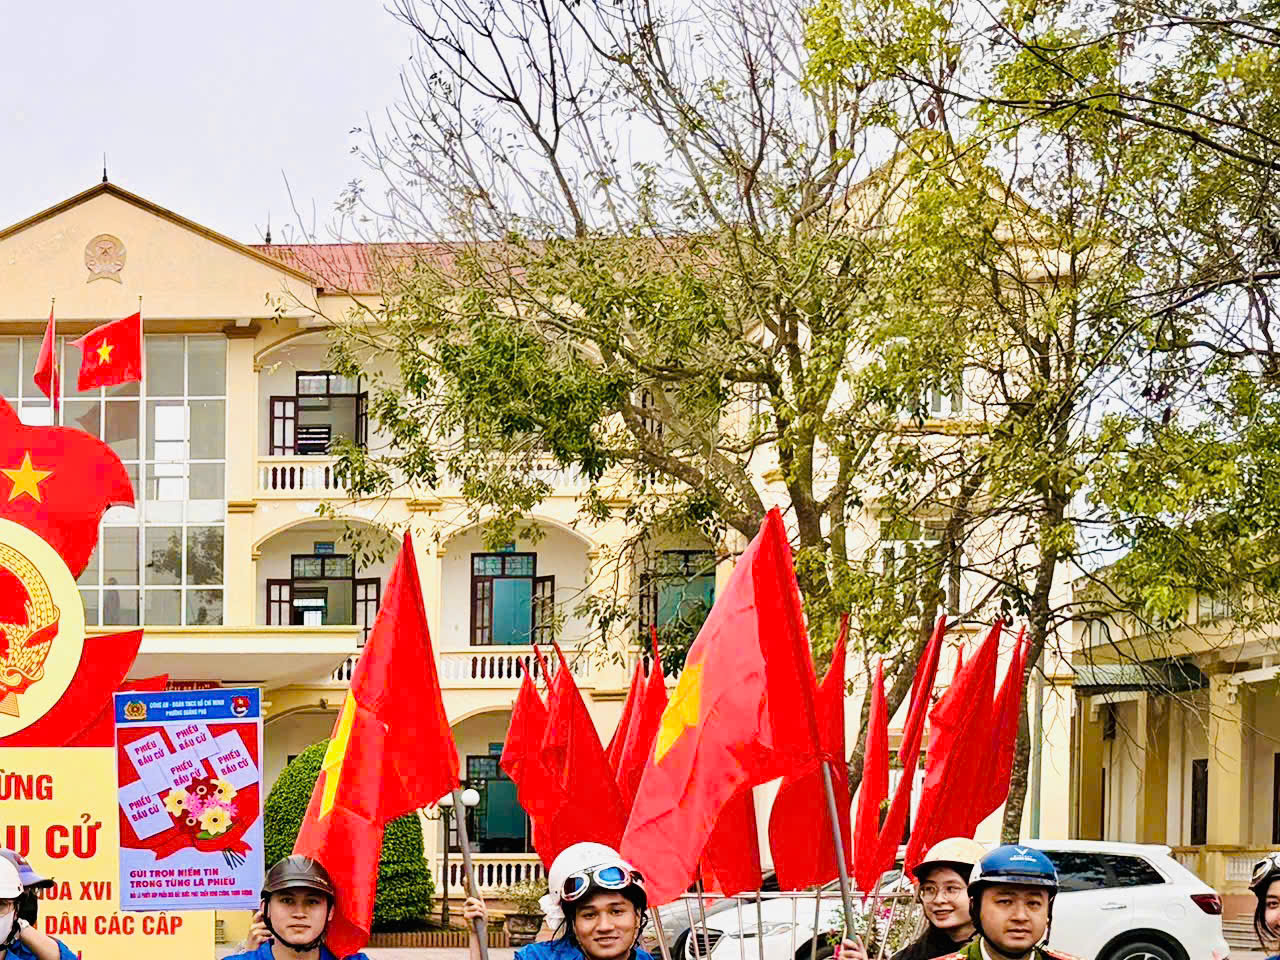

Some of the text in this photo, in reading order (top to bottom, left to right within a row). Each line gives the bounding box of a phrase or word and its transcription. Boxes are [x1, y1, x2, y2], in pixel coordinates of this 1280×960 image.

[45, 813, 102, 859] CỬ
[204, 868, 219, 877] TIN
[79, 881, 112, 901] XVI
[130, 879, 163, 889] TRONG
[45, 912, 87, 935] DÂN
[94, 911, 134, 935] CÁC
